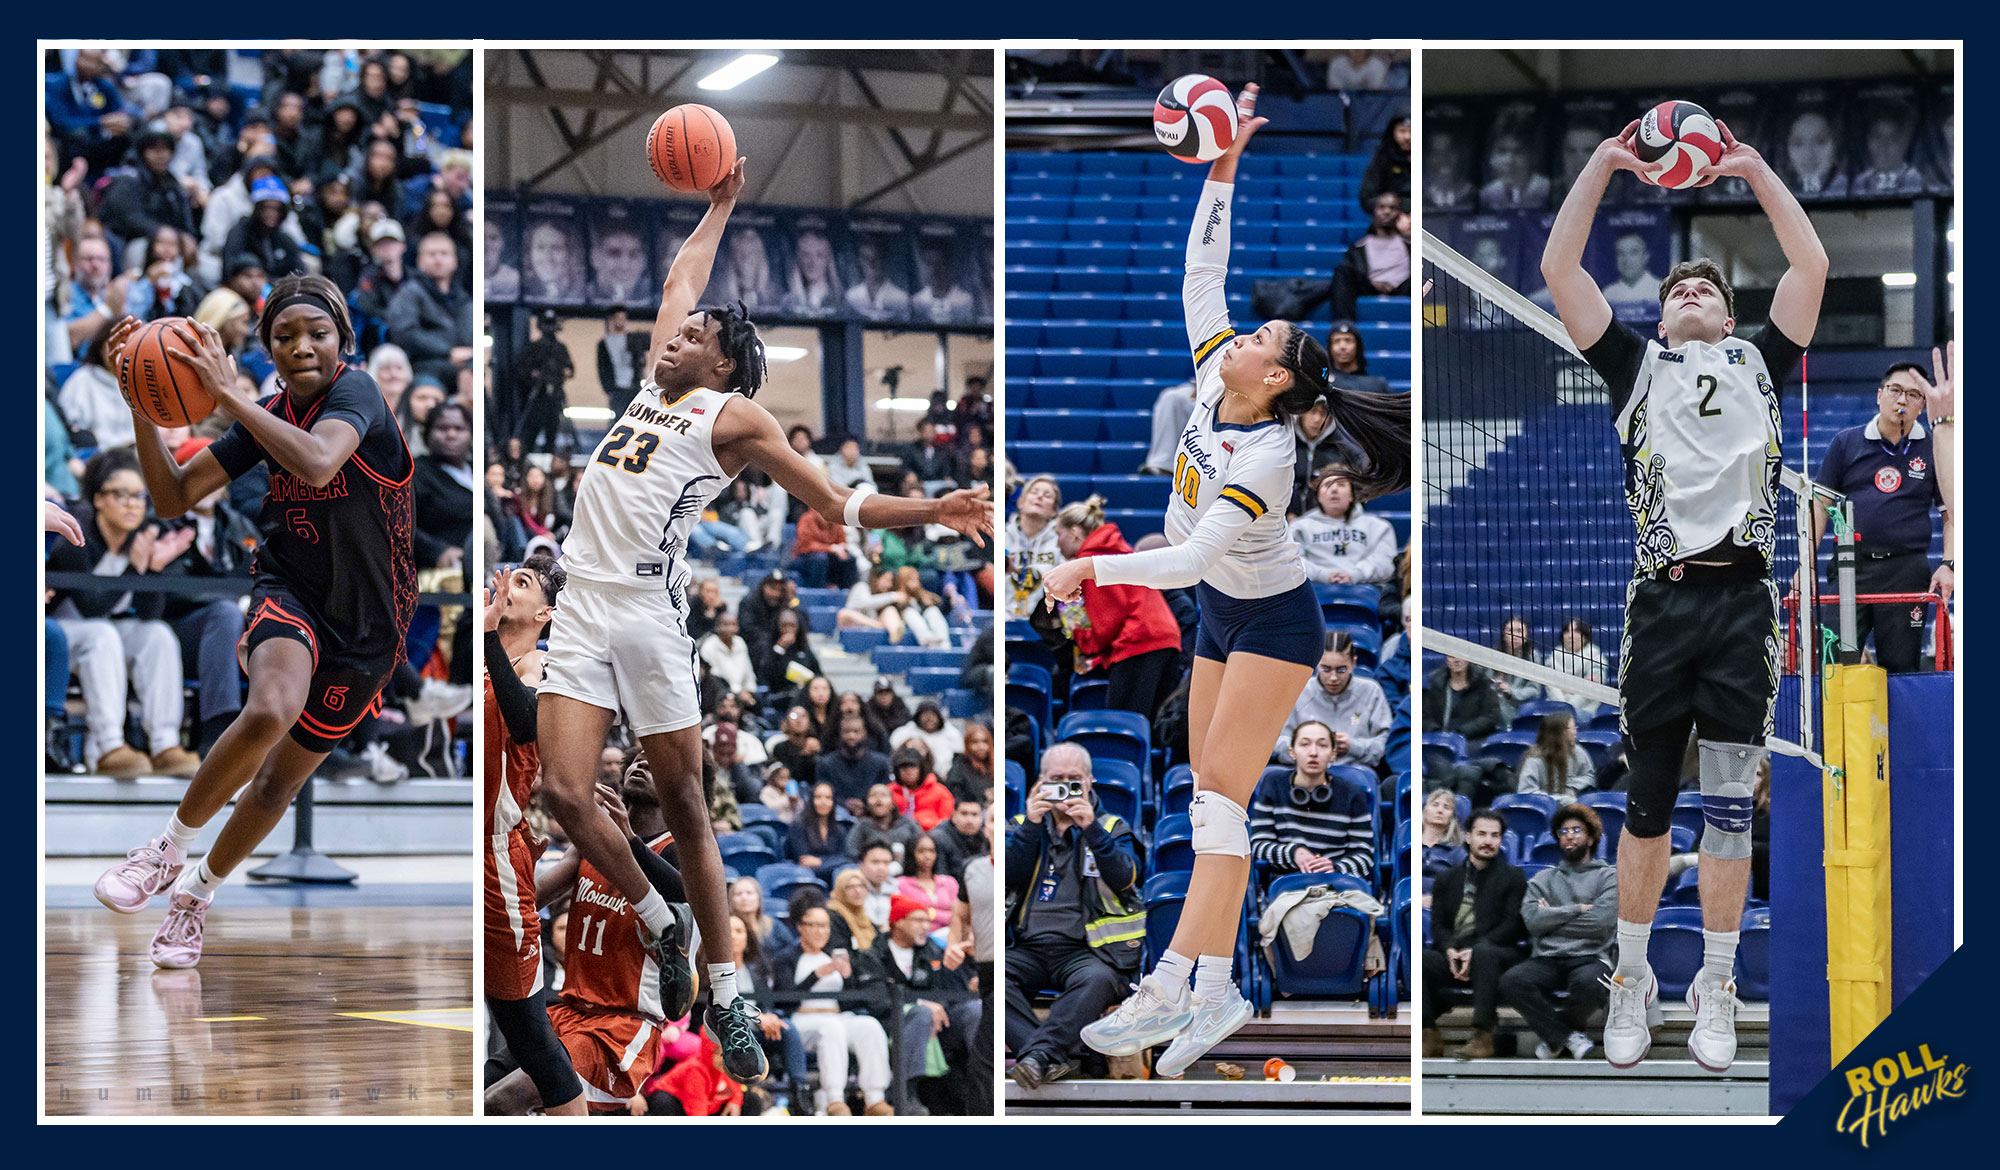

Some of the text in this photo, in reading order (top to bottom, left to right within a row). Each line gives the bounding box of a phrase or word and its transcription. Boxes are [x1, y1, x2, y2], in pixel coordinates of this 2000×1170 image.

[1658, 350, 1685, 364] OCAA
[1696, 374, 1722, 418] 2
[596, 424, 662, 475] 23
[1182, 424, 1217, 480] Humber
[272, 469, 349, 502] MBER
[1175, 451, 1201, 510] 10
[1312, 529, 1368, 547] HUMBER
[322, 685, 350, 712] 6
[577, 914, 607, 956] 11
